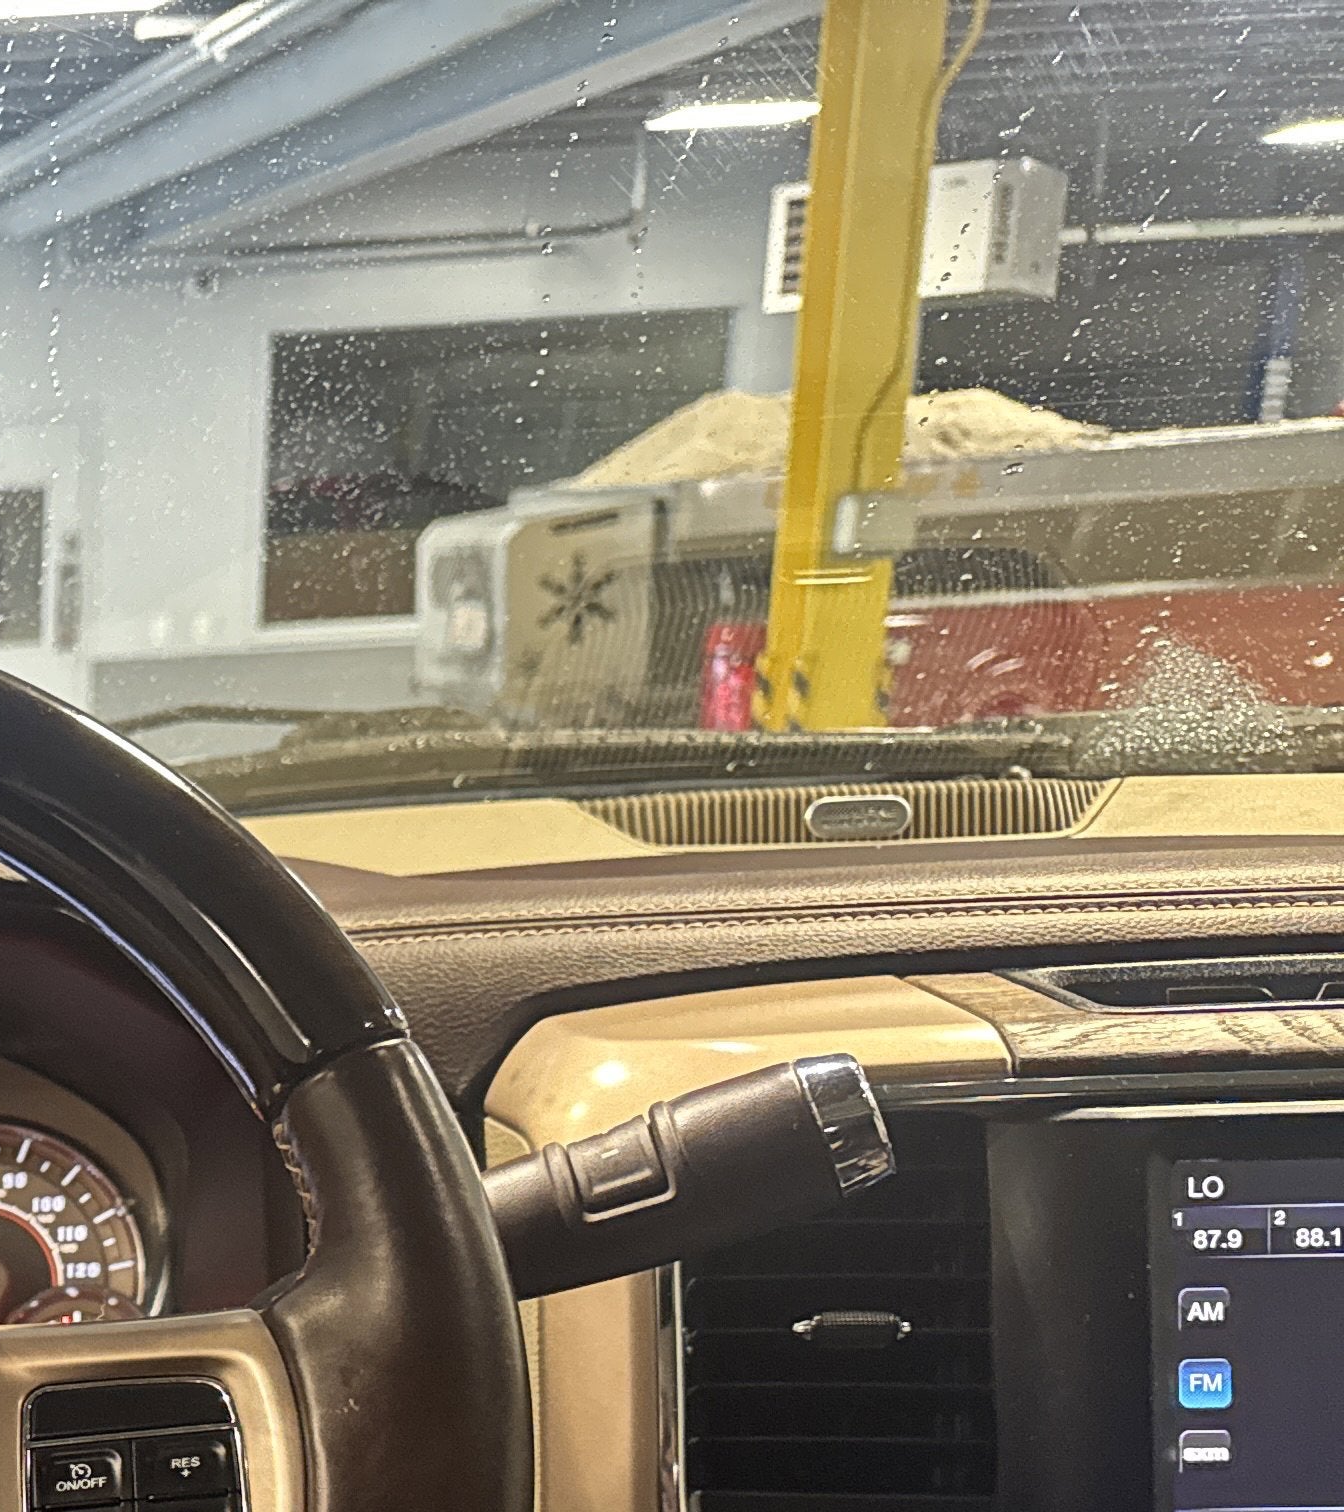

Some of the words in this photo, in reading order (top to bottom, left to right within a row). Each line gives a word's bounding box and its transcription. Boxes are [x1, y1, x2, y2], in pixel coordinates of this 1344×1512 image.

[1187, 1175, 1224, 1199] LO
[1173, 1211, 1184, 1227] 1
[1273, 1209, 1287, 1226] 2
[1193, 1229, 1243, 1250] 87.9
[1295, 1227, 1342, 1248] 88.1
[1187, 1302, 1224, 1322] AM
[1189, 1373, 1223, 1392] FM
[170, 1456, 201, 1470] RES
[55, 1476, 108, 1492] ON/OFF
